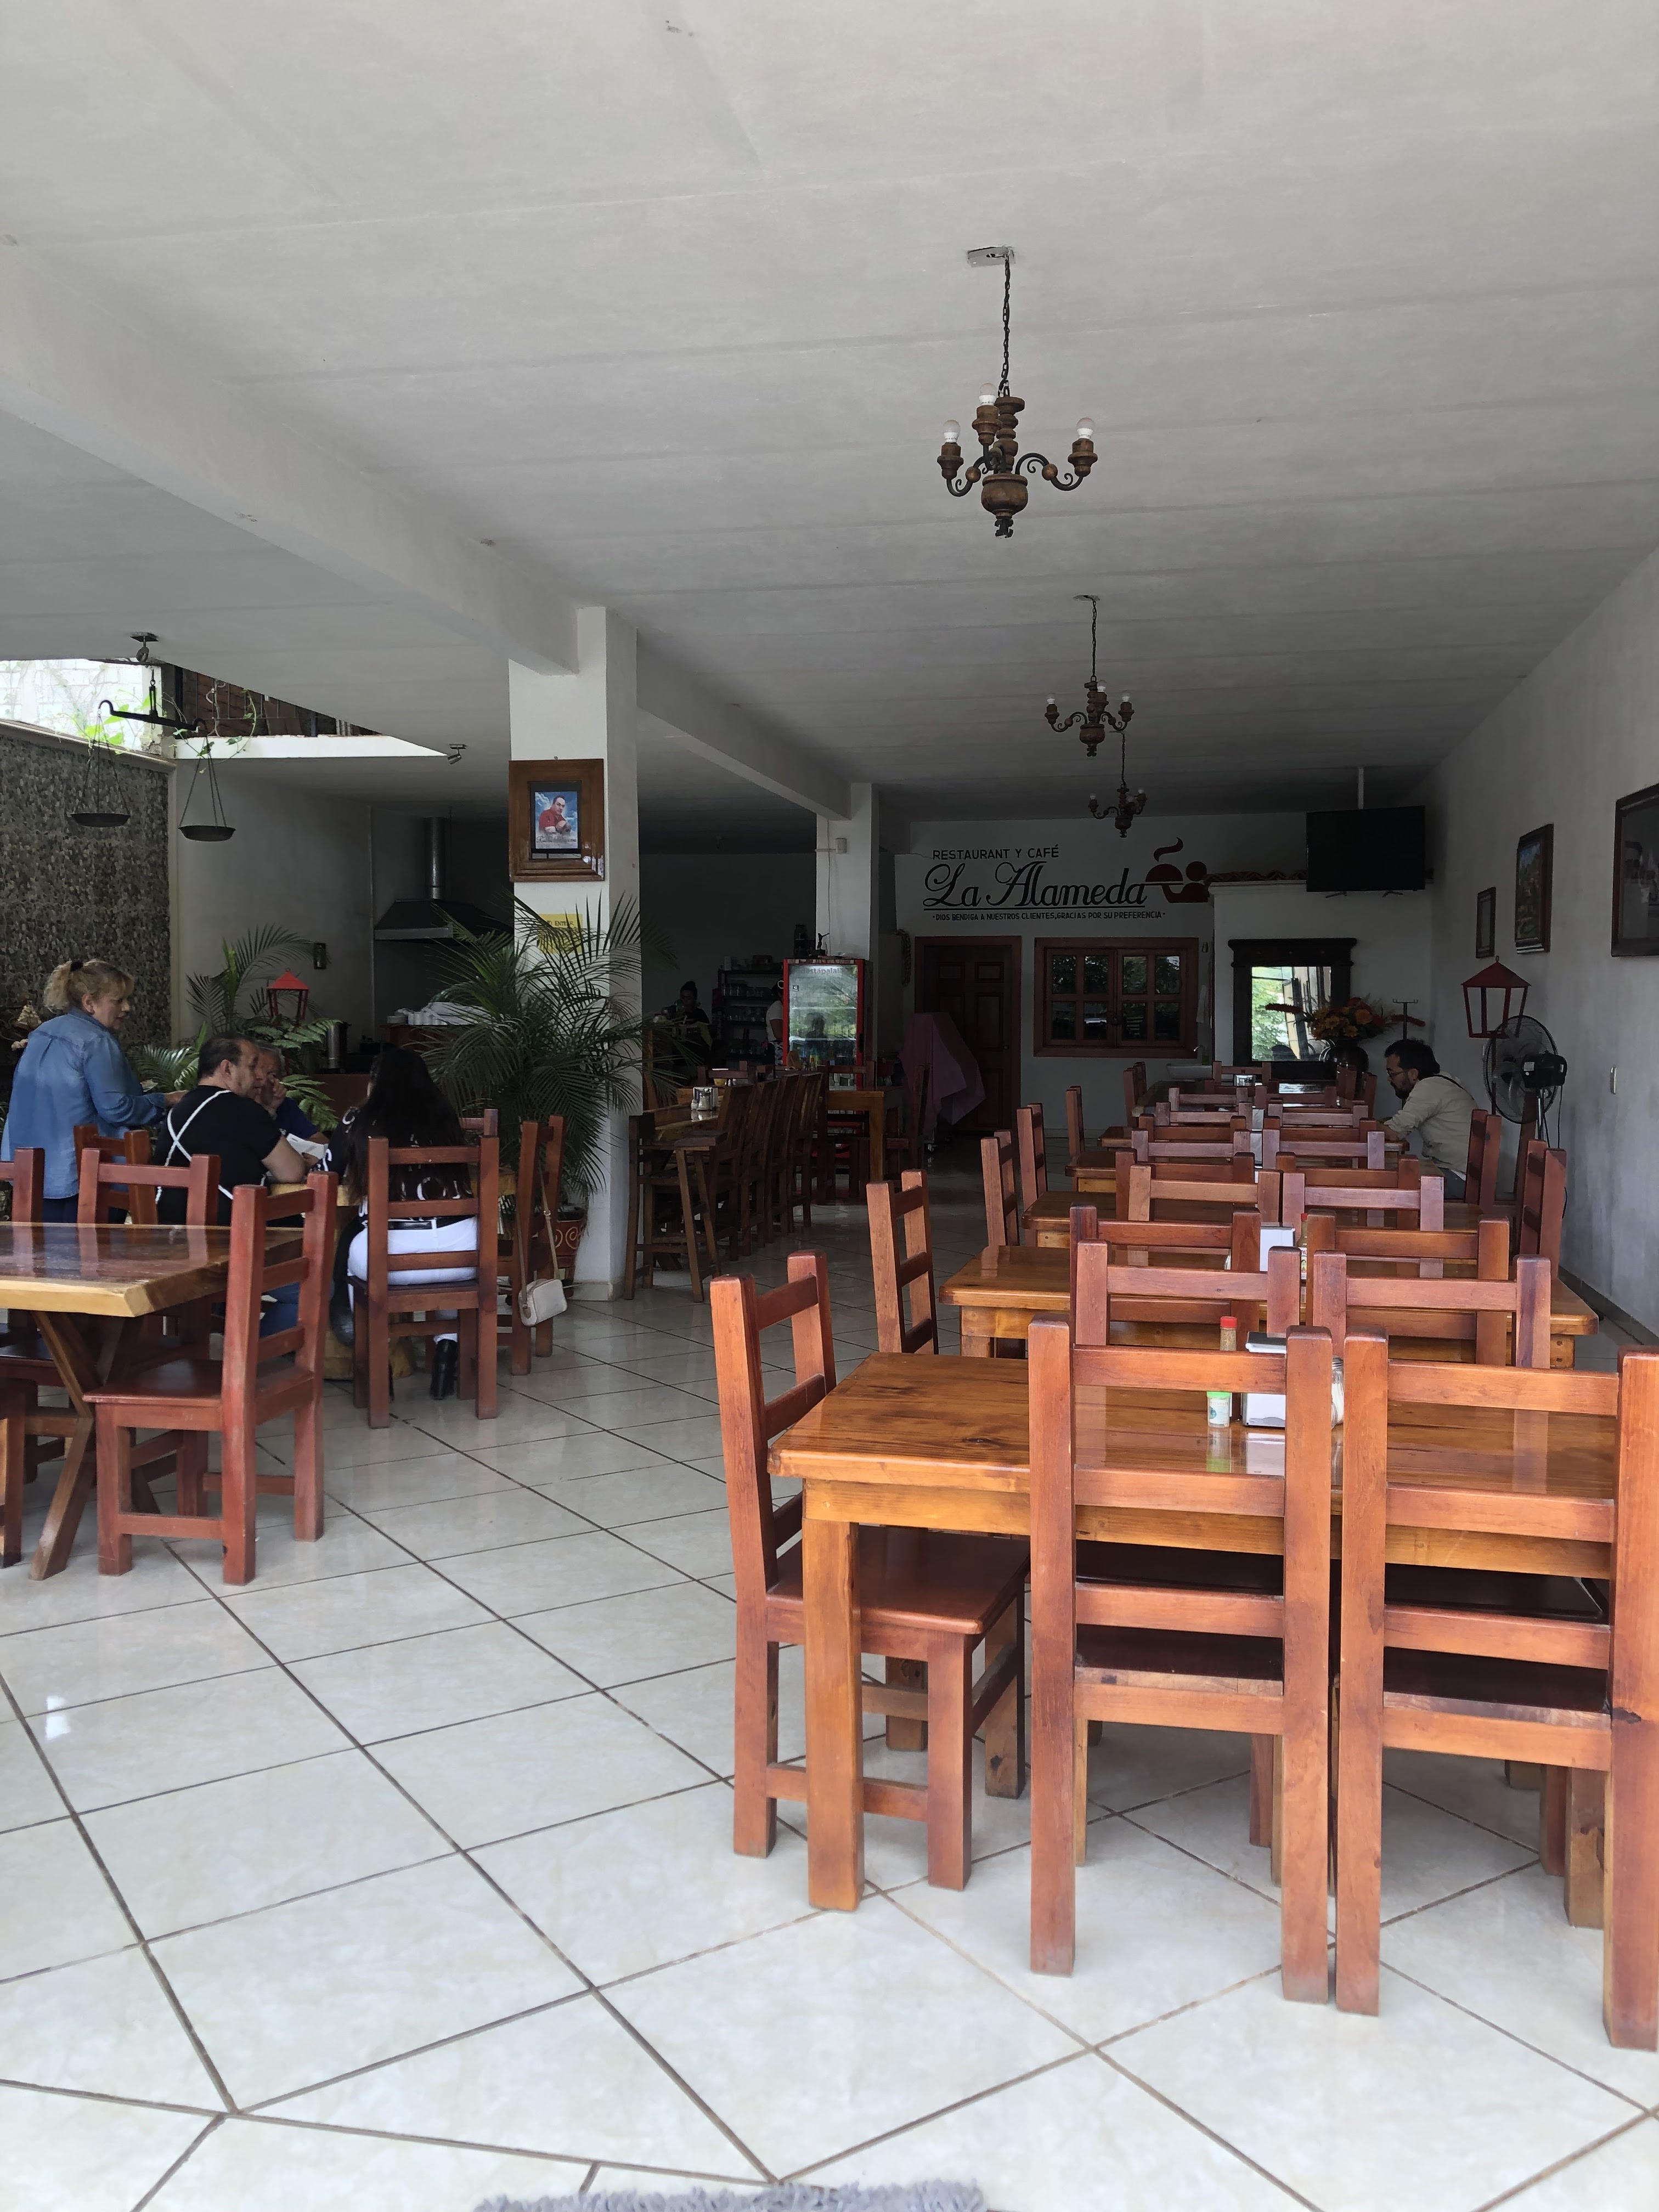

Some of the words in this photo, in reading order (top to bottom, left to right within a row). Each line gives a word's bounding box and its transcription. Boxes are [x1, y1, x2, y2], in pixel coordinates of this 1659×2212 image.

[933, 849, 1011, 860] RESTAURANT
[1015, 848, 1022, 859] Y
[1028, 844, 1059, 859] CAFÉ
[922, 862, 982, 907] La
[985, 861, 1148, 907] Alameda
